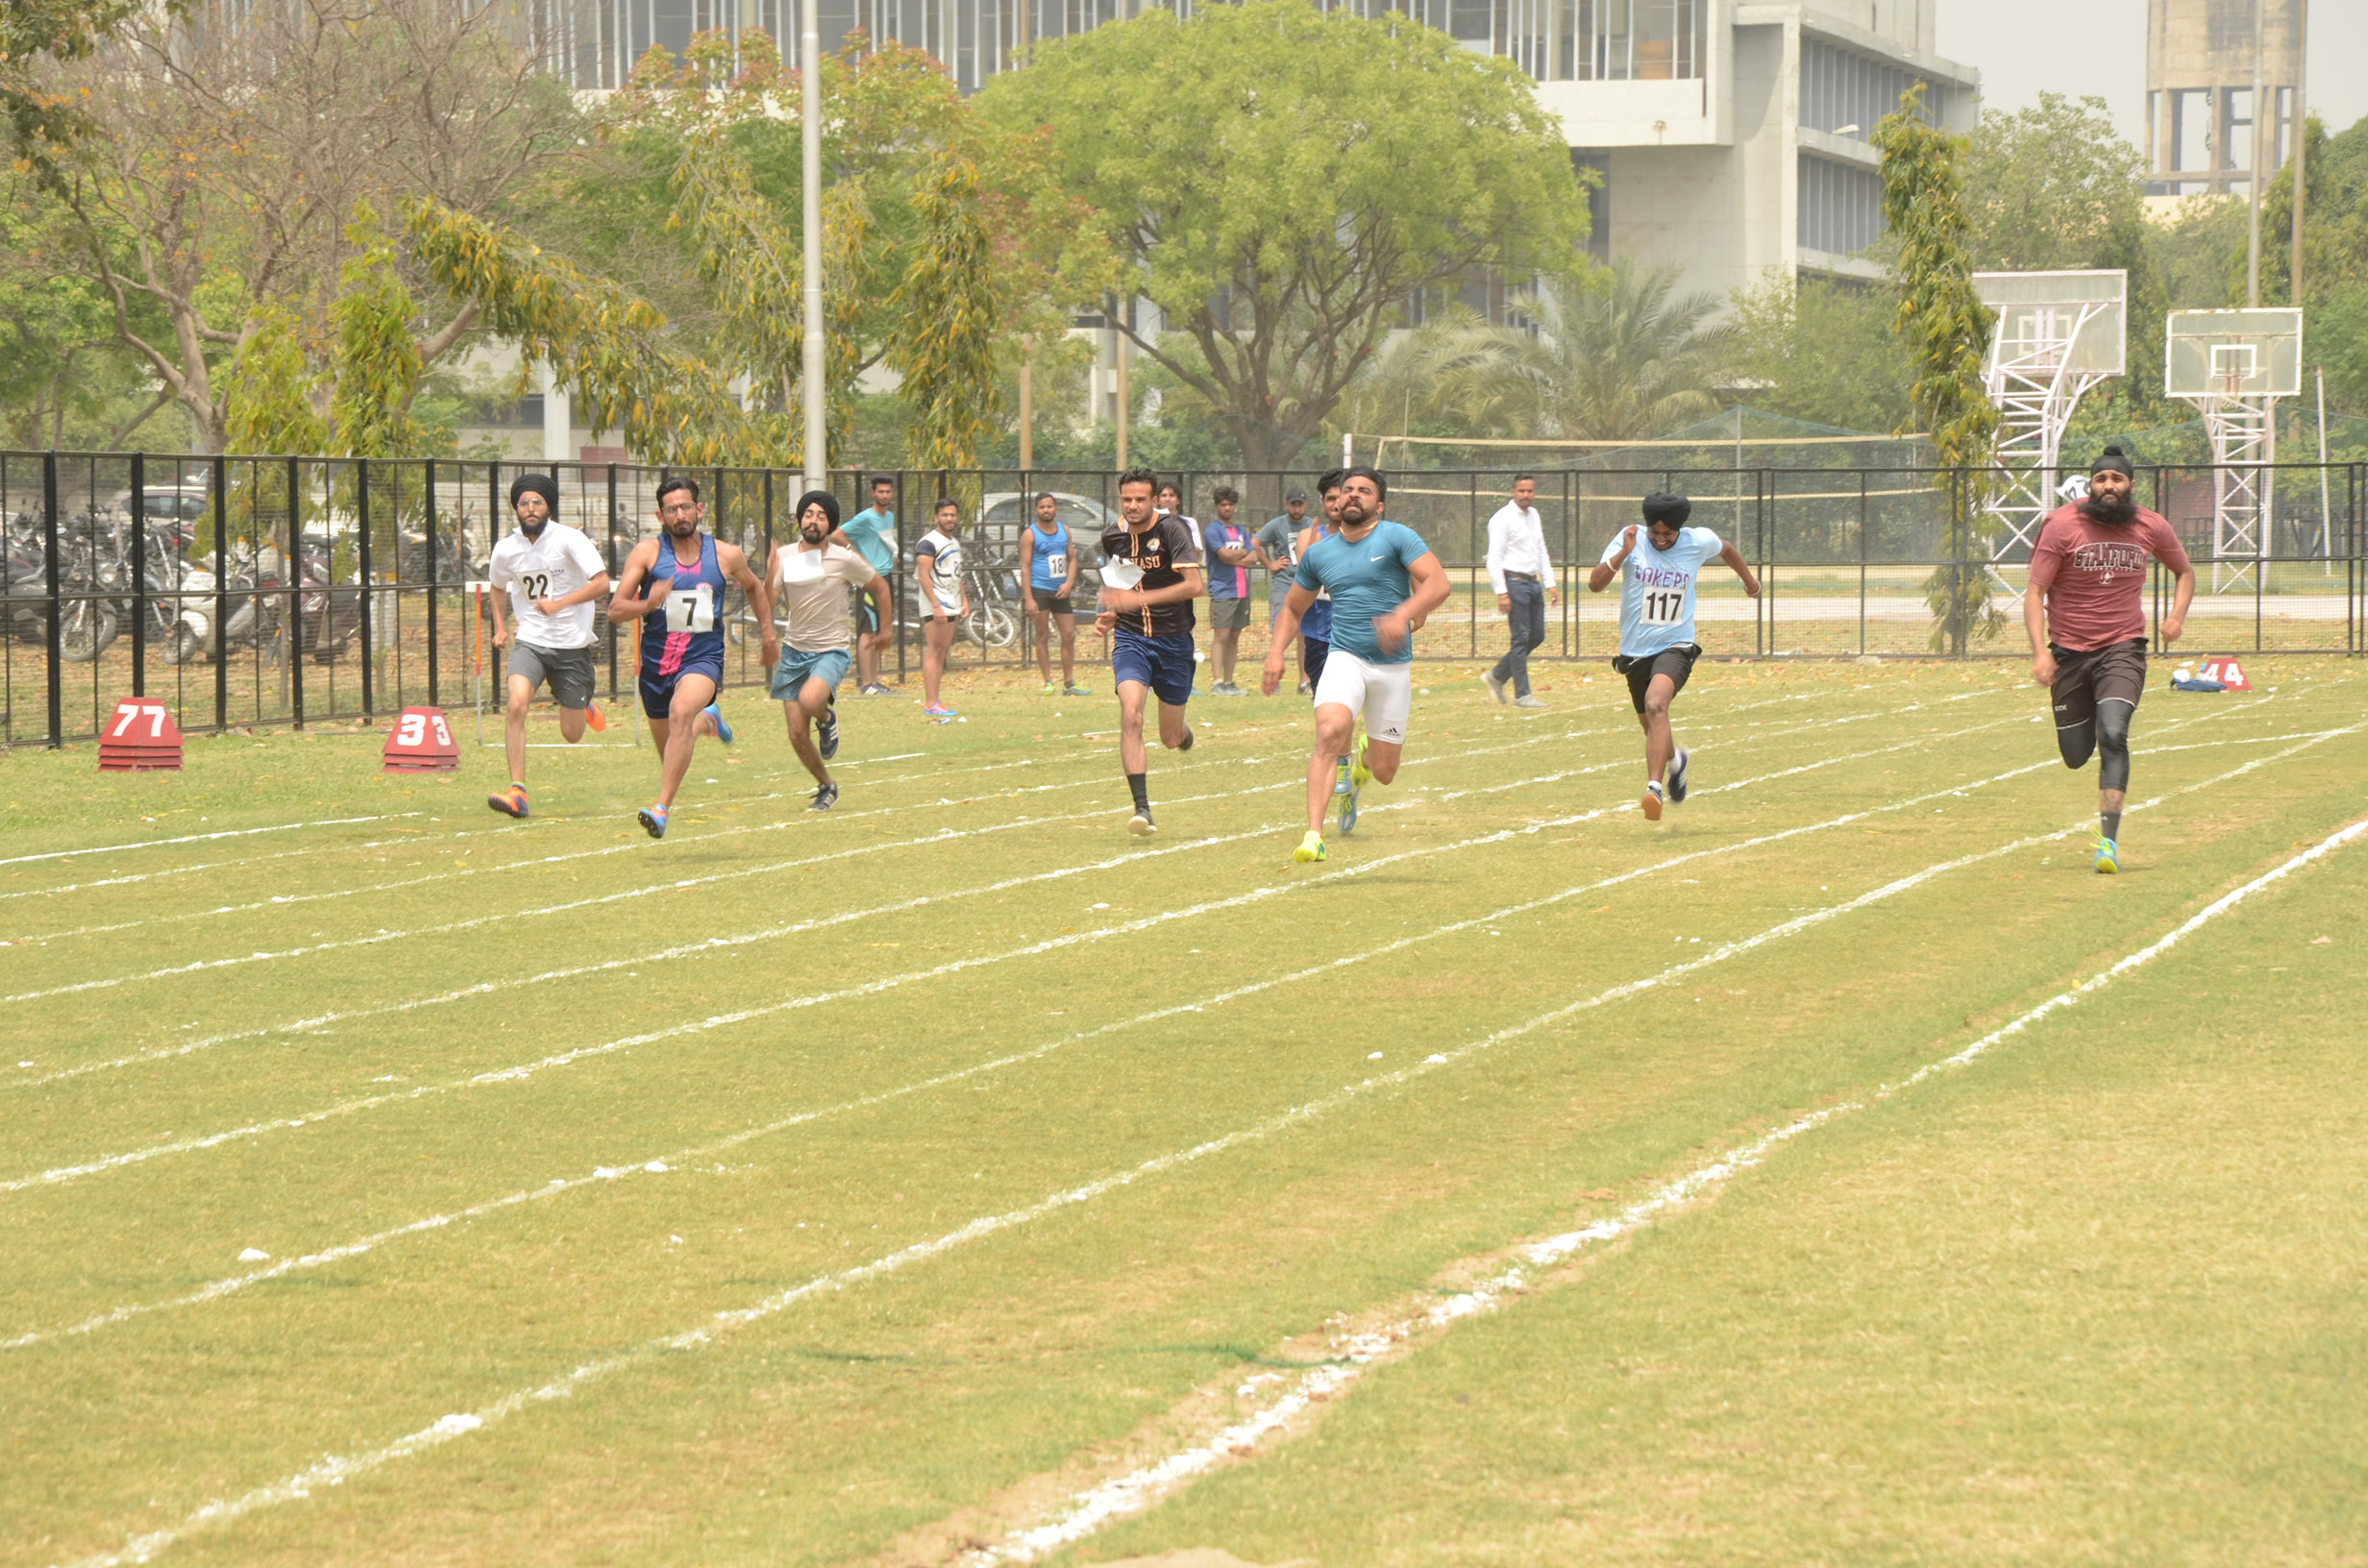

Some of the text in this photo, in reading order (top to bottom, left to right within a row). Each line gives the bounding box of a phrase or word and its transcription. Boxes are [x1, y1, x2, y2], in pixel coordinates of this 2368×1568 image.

[523, 574, 549, 600] 22
[682, 598, 697, 626] 7
[1646, 592, 1682, 622] 117
